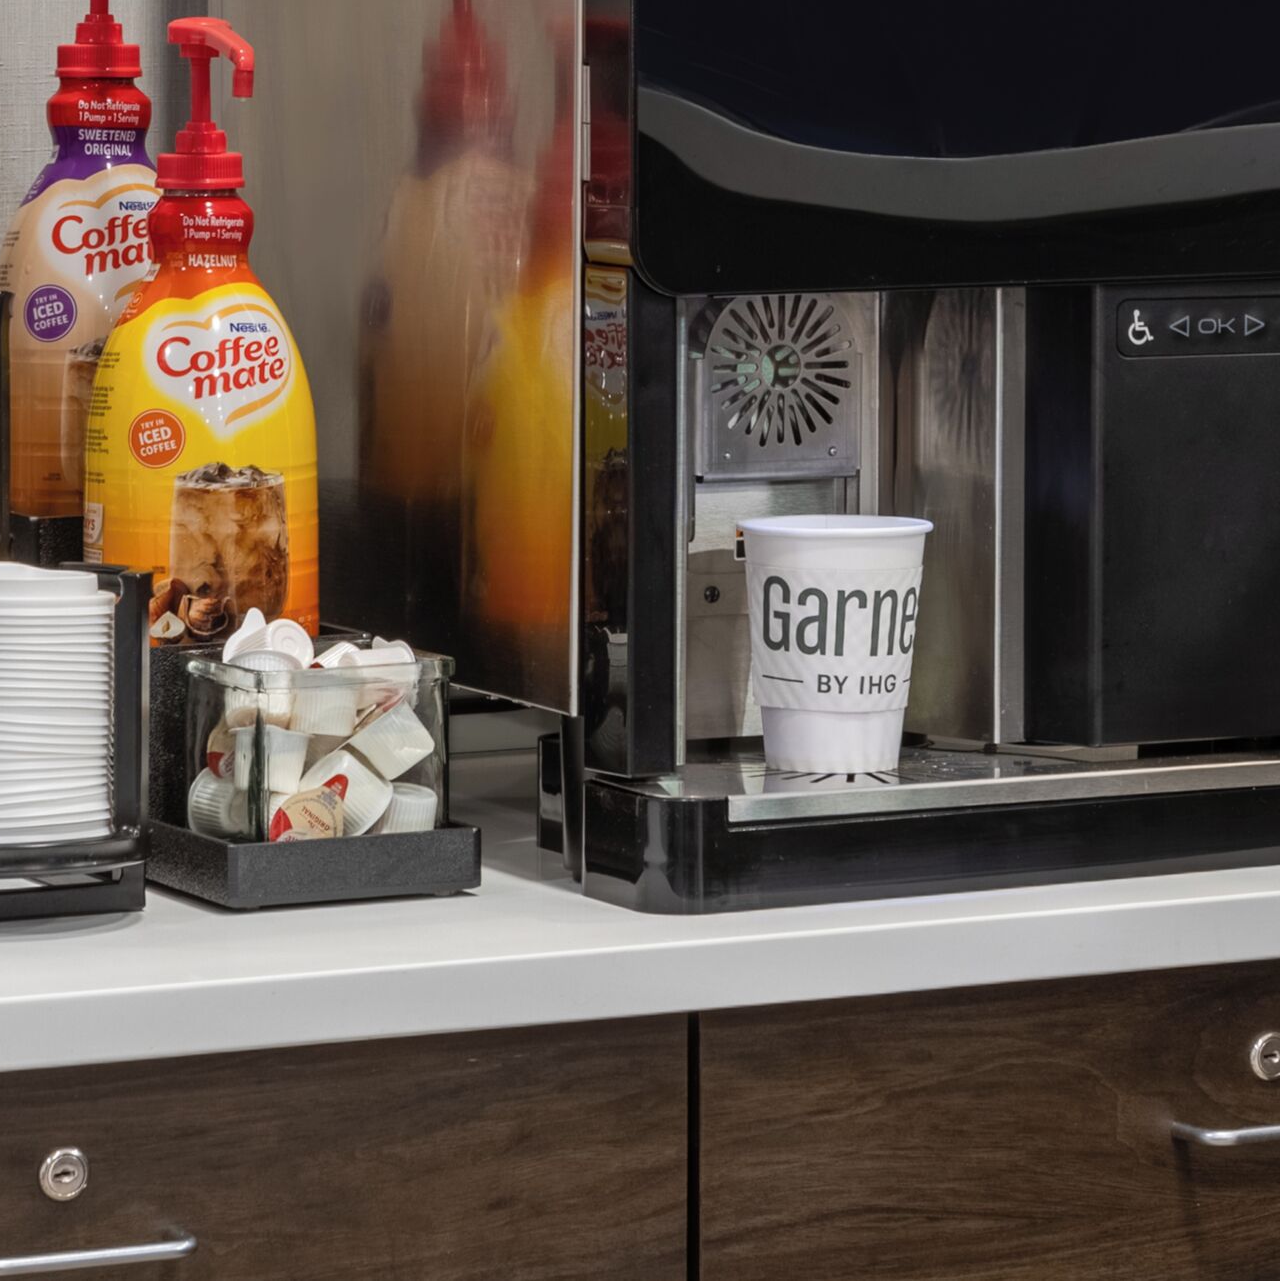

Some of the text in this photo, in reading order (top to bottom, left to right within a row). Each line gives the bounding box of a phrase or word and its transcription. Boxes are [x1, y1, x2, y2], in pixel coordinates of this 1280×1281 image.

[78, 100, 89, 109] Do
[90, 101, 106, 110] Not
[84, 112, 106, 124] Pump
[118, 113, 139, 125] Serving
[78, 129, 136, 142] SWEETENED
[84, 143, 132, 156] ORIGINAL
[182, 216, 194, 226] Do
[195, 216, 209, 226] Not
[51, 214, 148, 254] Coffe
[189, 228, 210, 241] Pump
[221, 229, 242, 242] Serving
[188, 254, 237, 267] HAZELNUT
[35, 295, 47, 305] TRY
[33, 301, 64, 319] ICED
[33, 315, 69, 331] COFFEE
[1198, 318, 1235, 334] OK
[157, 336, 279, 378] Coffee
[193, 358, 285, 399] mate
[140, 418, 165, 429] TRY IN
[138, 426, 172, 446] ICED
[140, 440, 177, 457] COFFEE
[763, 575, 918, 657] Garne
[817, 674, 897, 695] BY IHG
[302, 805, 330, 831] ORIGINAL
